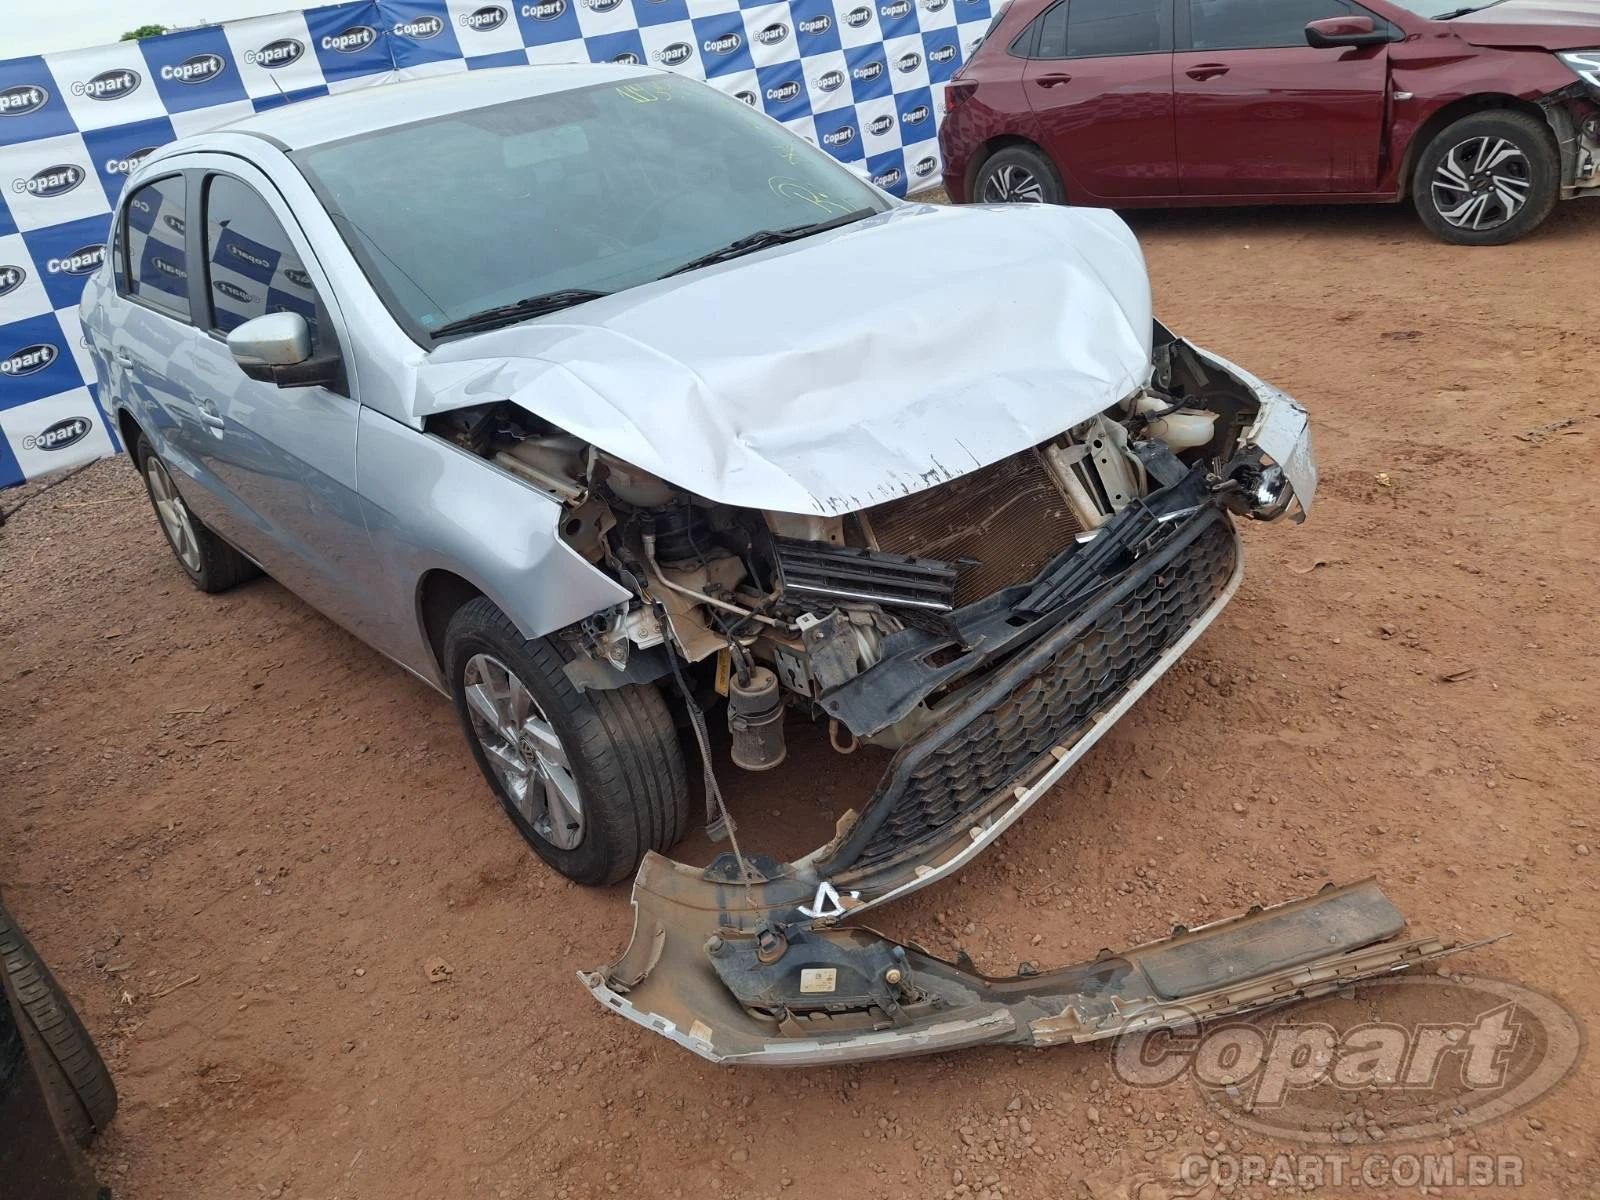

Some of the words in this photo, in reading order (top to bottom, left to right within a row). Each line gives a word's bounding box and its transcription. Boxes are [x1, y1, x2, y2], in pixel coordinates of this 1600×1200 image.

[522, 1, 561, 17] Copart
[881, 2, 908, 16] Copart
[459, 11, 501, 27] Copart
[799, 17, 828, 32] Copart
[841, 10, 868, 24] Copart
[394, 20, 438, 35] Copart
[753, 26, 784, 41] Copart
[322, 30, 370, 49] Copart
[704, 36, 737, 51] Copart
[244, 43, 296, 64] Copart
[652, 45, 687, 61] Copart
[929, 48, 954, 61] Copart
[160, 58, 217, 80] Copart
[893, 56, 918, 70] Copart
[853, 64, 880, 79] Copart
[71, 72, 131, 96] Copart
[811, 74, 841, 88] Copart
[766, 84, 797, 99] Copart
[0, 89, 38, 112] part
[902, 108, 927, 122] Copart
[864, 118, 891, 133] Copart
[823, 129, 852, 144] Copart
[910, 159, 934, 173] Copart
[12, 168, 75, 193] Copart
[873, 171, 898, 185] Copart
[0, 347, 49, 372] opart
[23, 421, 82, 450] Copart
